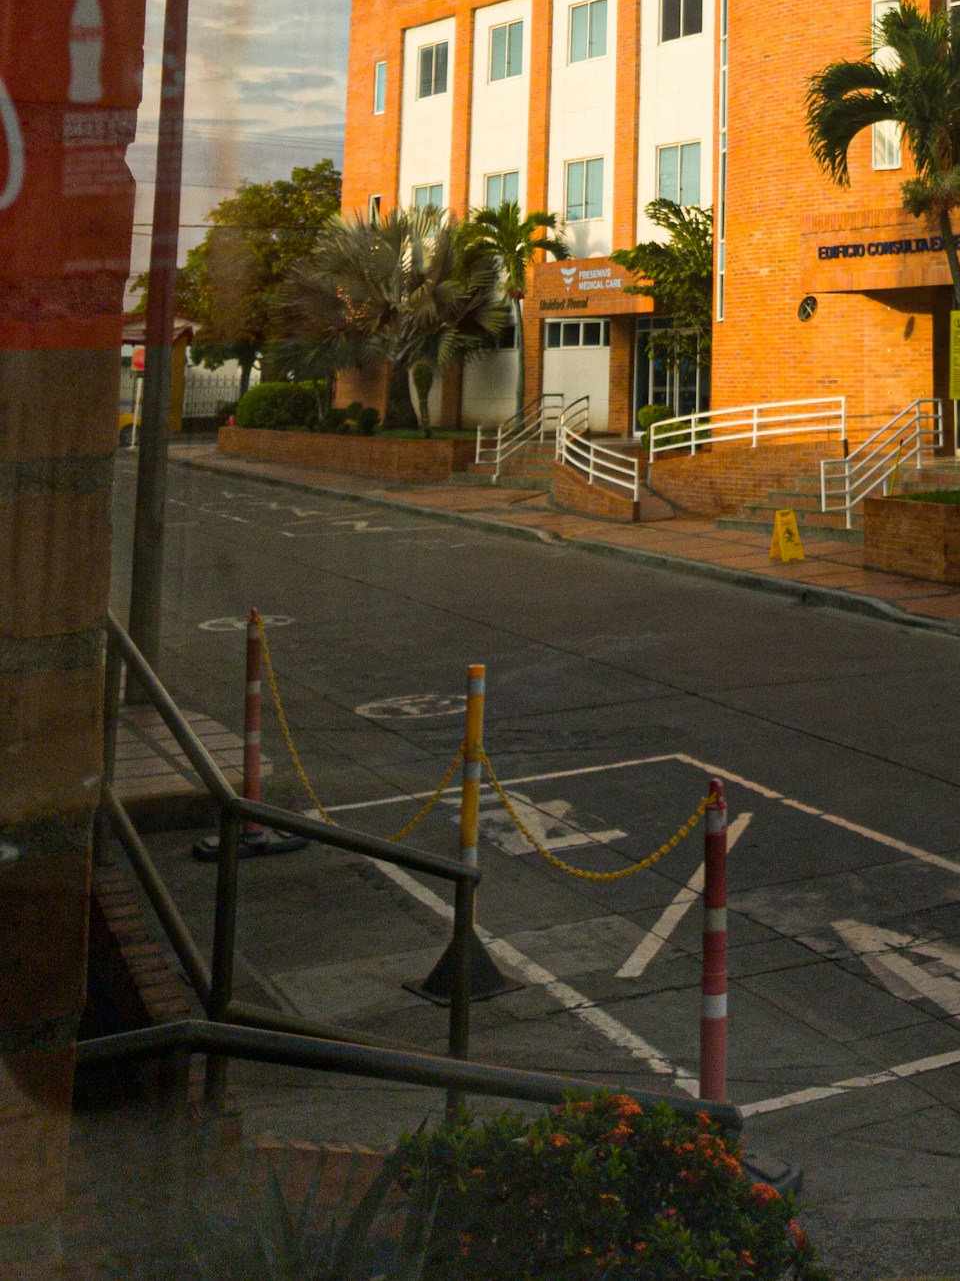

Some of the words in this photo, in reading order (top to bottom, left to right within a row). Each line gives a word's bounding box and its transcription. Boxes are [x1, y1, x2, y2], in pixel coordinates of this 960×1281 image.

[818, 244, 864, 259] EDIFICIO
[867, 238, 929, 256] CONSULTA
[579, 268, 611, 279] FRESENIUS
[578, 280, 604, 291] MEDICAL
[605, 278, 622, 288] CARE
